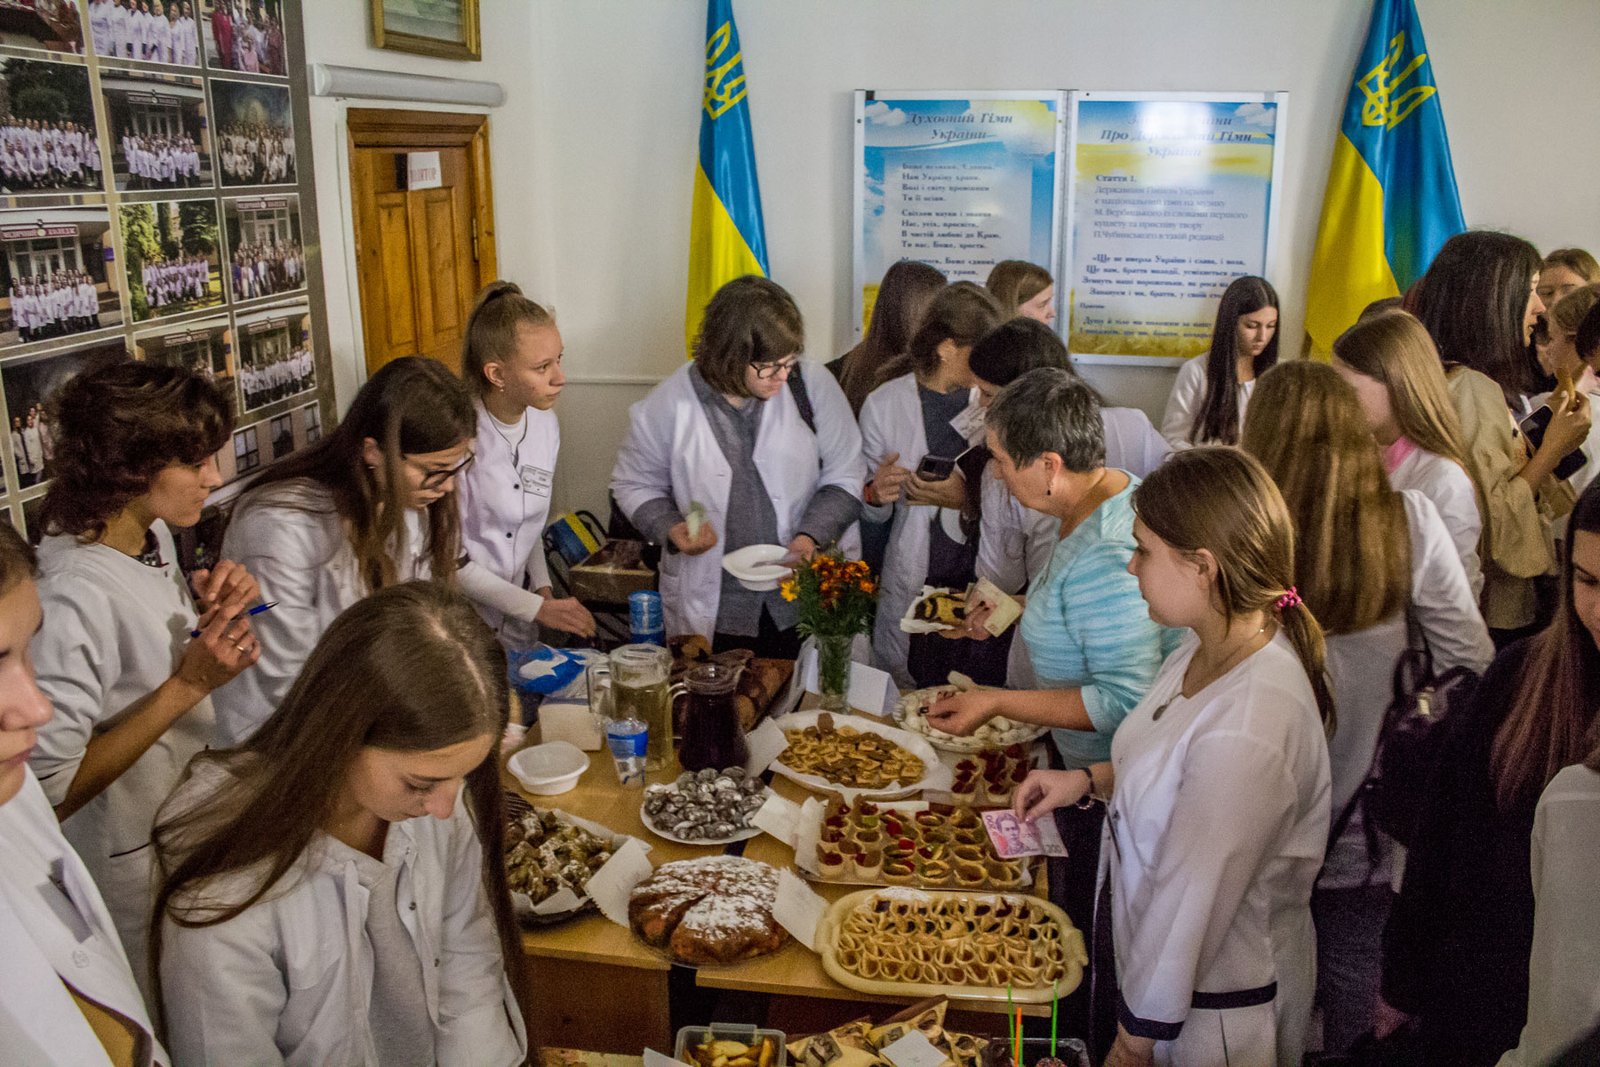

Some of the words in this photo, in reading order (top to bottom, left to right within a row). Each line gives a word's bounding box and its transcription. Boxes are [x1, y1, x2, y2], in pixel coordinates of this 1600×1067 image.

[906, 113, 974, 126] Духовний
[980, 113, 1013, 124] Гімн
[931, 129, 987, 142] України
[1101, 130, 1129, 142] Про
[1219, 131, 1252, 142] Гімн
